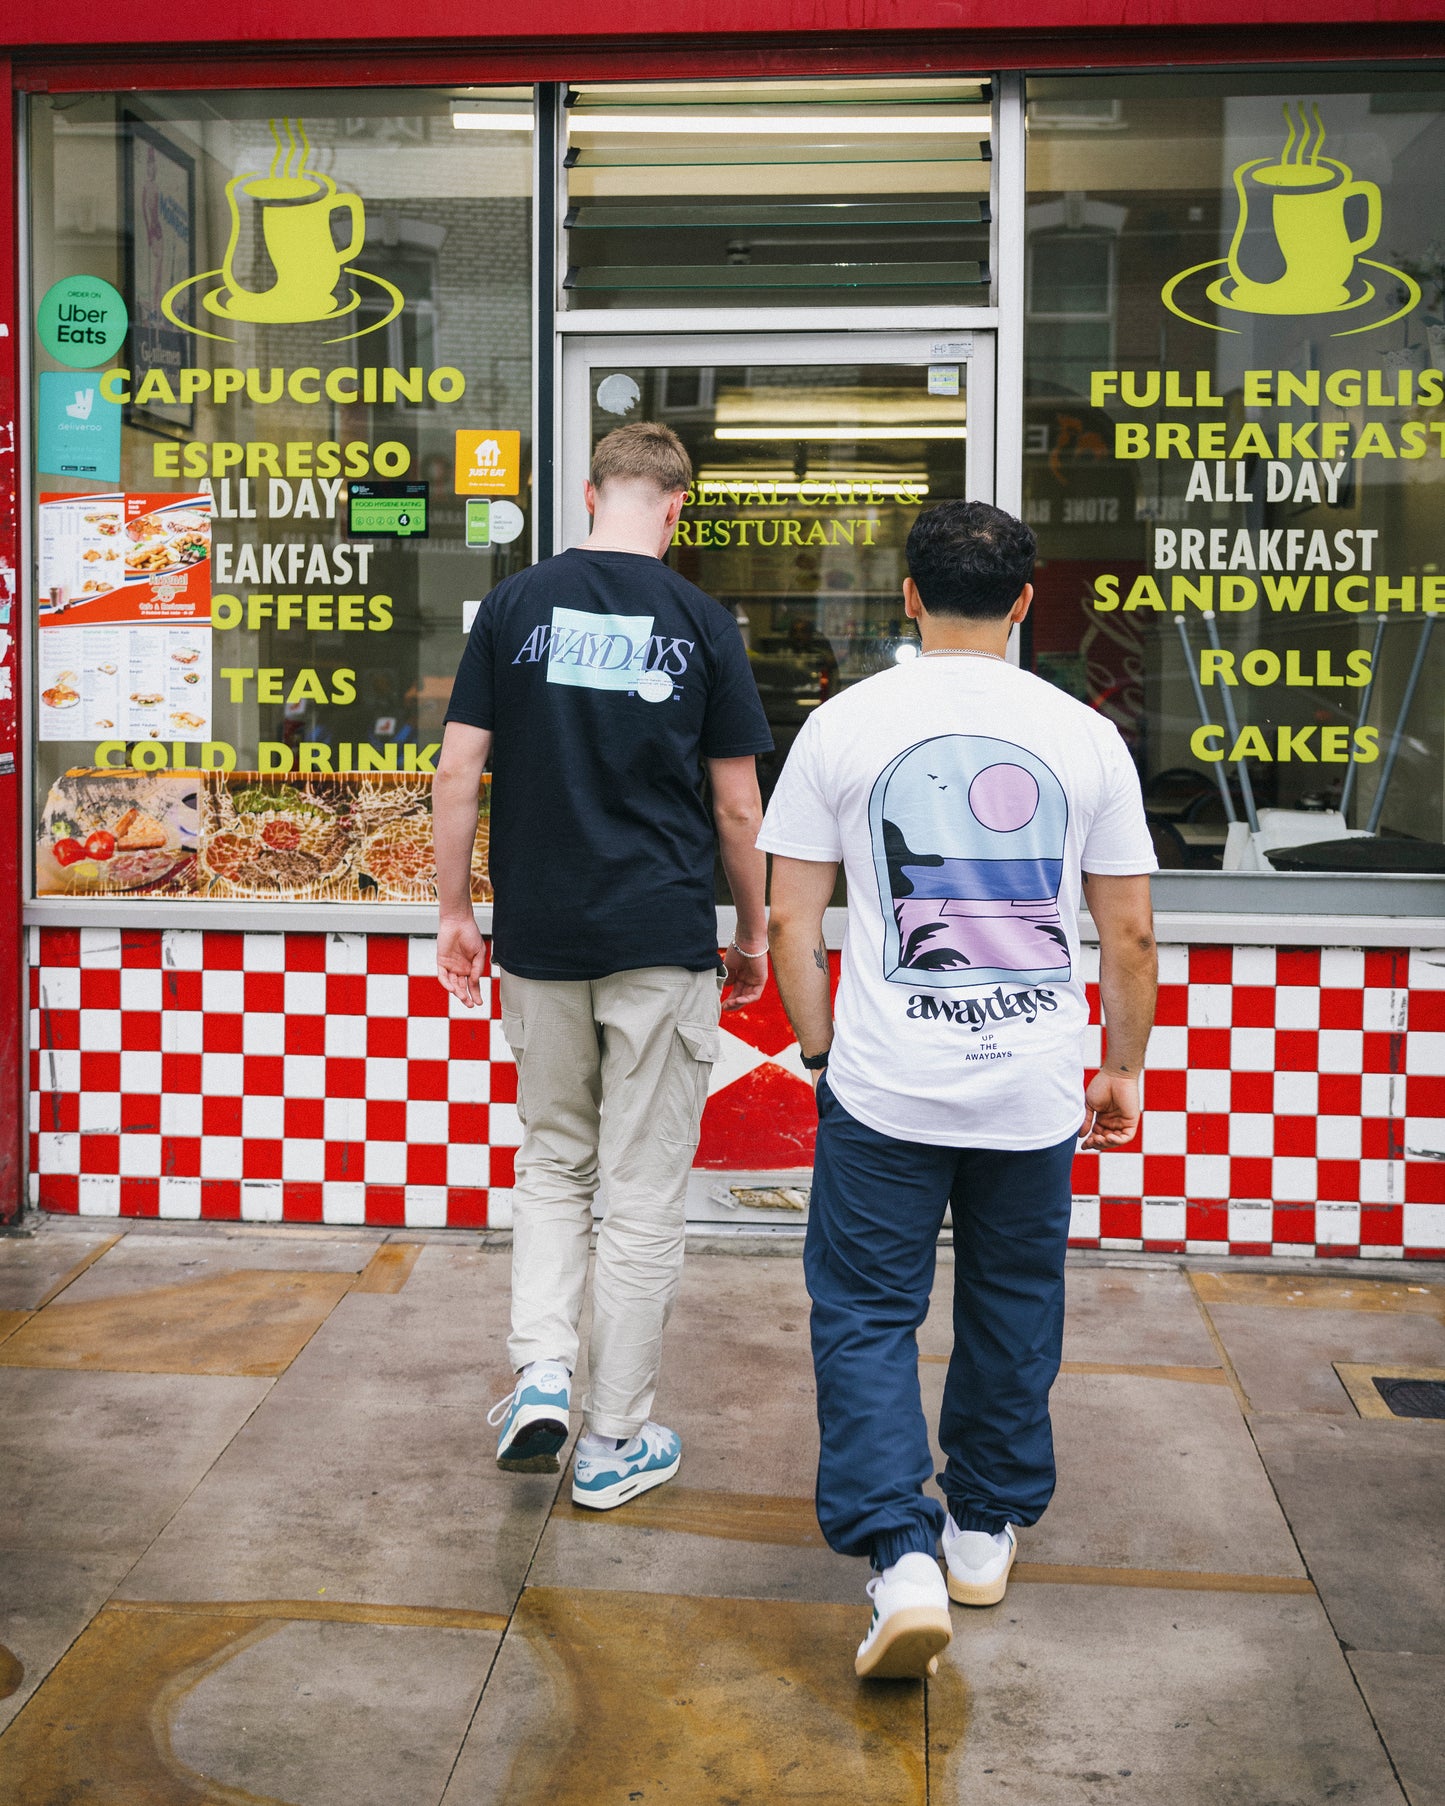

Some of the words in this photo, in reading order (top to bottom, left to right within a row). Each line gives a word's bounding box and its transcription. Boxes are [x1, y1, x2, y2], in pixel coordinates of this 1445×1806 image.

[58, 303, 108, 323] Uber
[57, 325, 107, 345] Eats
[100, 366, 466, 405] CAPPUCCINO
[1090, 370, 1224, 408] FULL
[1243, 368, 1445, 408] ENGLIS
[58, 424, 102, 432] deliveroo
[152, 440, 411, 480] ESPRESSO
[468, 468, 490, 477] JUST
[489, 468, 506, 477] EAT
[197, 478, 257, 519] ALL
[268, 478, 344, 519] DAY
[682, 479, 789, 506] SENAL
[796, 479, 885, 506] CAFE
[894, 479, 923, 506] &
[1185, 460, 1254, 502] ALL
[1266, 460, 1348, 504] DAY
[670, 519, 881, 547] RESTURANT
[1155, 528, 1379, 572] BREAKFAST
[216, 543, 374, 585] EAKFAST
[211, 593, 394, 632] OFFEES
[1093, 574, 1445, 613] SANDWICHE
[511, 624, 695, 677] AWAYDAYS
[1199, 649, 1373, 688] ROLLS
[219, 667, 357, 705] TEAS
[94, 740, 237, 773] COLD
[257, 741, 442, 774] DRINK
[1190, 725, 1380, 764] CAKES
[905, 986, 1058, 1033] awaydays
[965, 1050, 1013, 1061] AWAYDAYS
[979, 1043, 998, 1051] THE
[981, 1034, 994, 1042] UP
